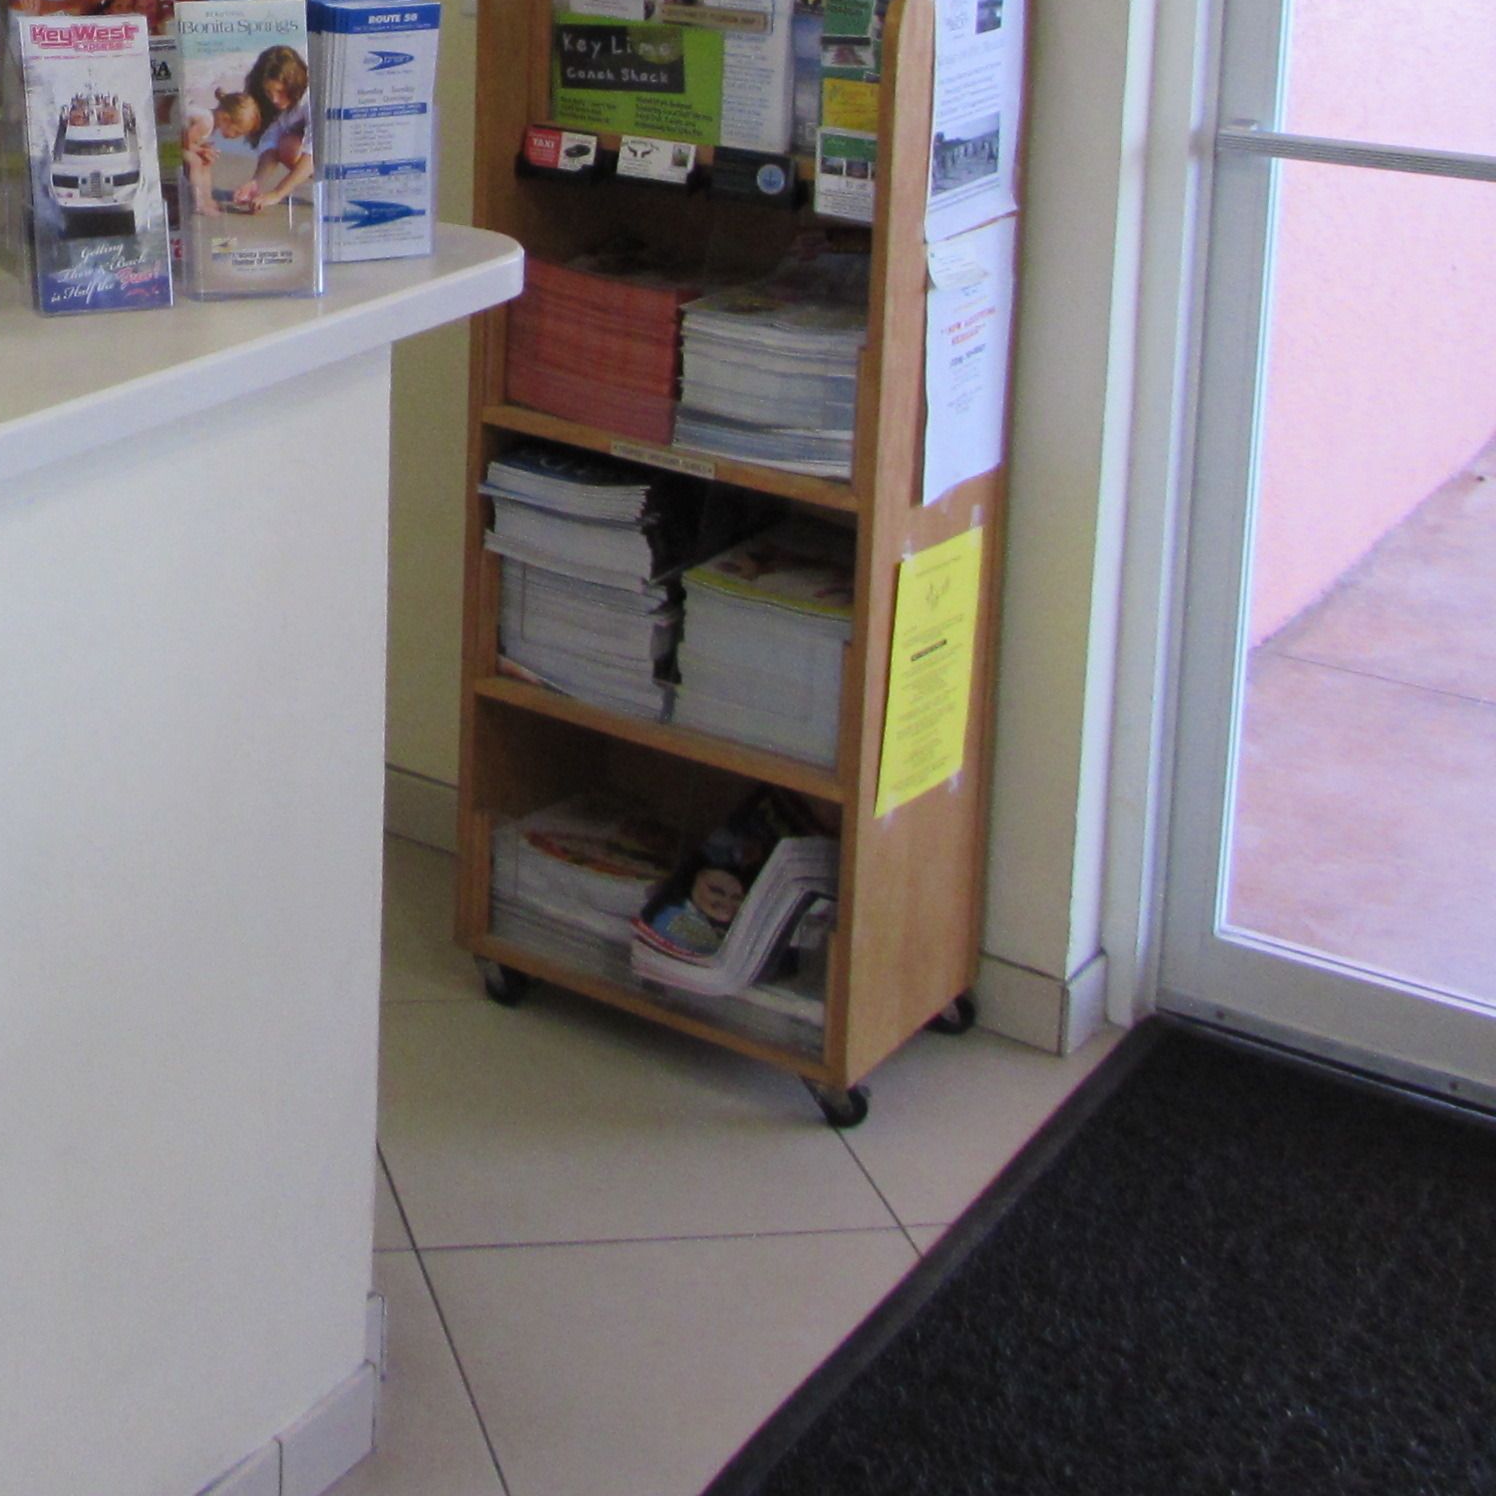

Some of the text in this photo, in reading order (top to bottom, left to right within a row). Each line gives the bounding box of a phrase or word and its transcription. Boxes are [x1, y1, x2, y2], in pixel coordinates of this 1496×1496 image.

[368, 13, 402, 25] ROUTE
[562, 31, 672, 60] Key Lime
[566, 66, 669, 84] Conch Shack
